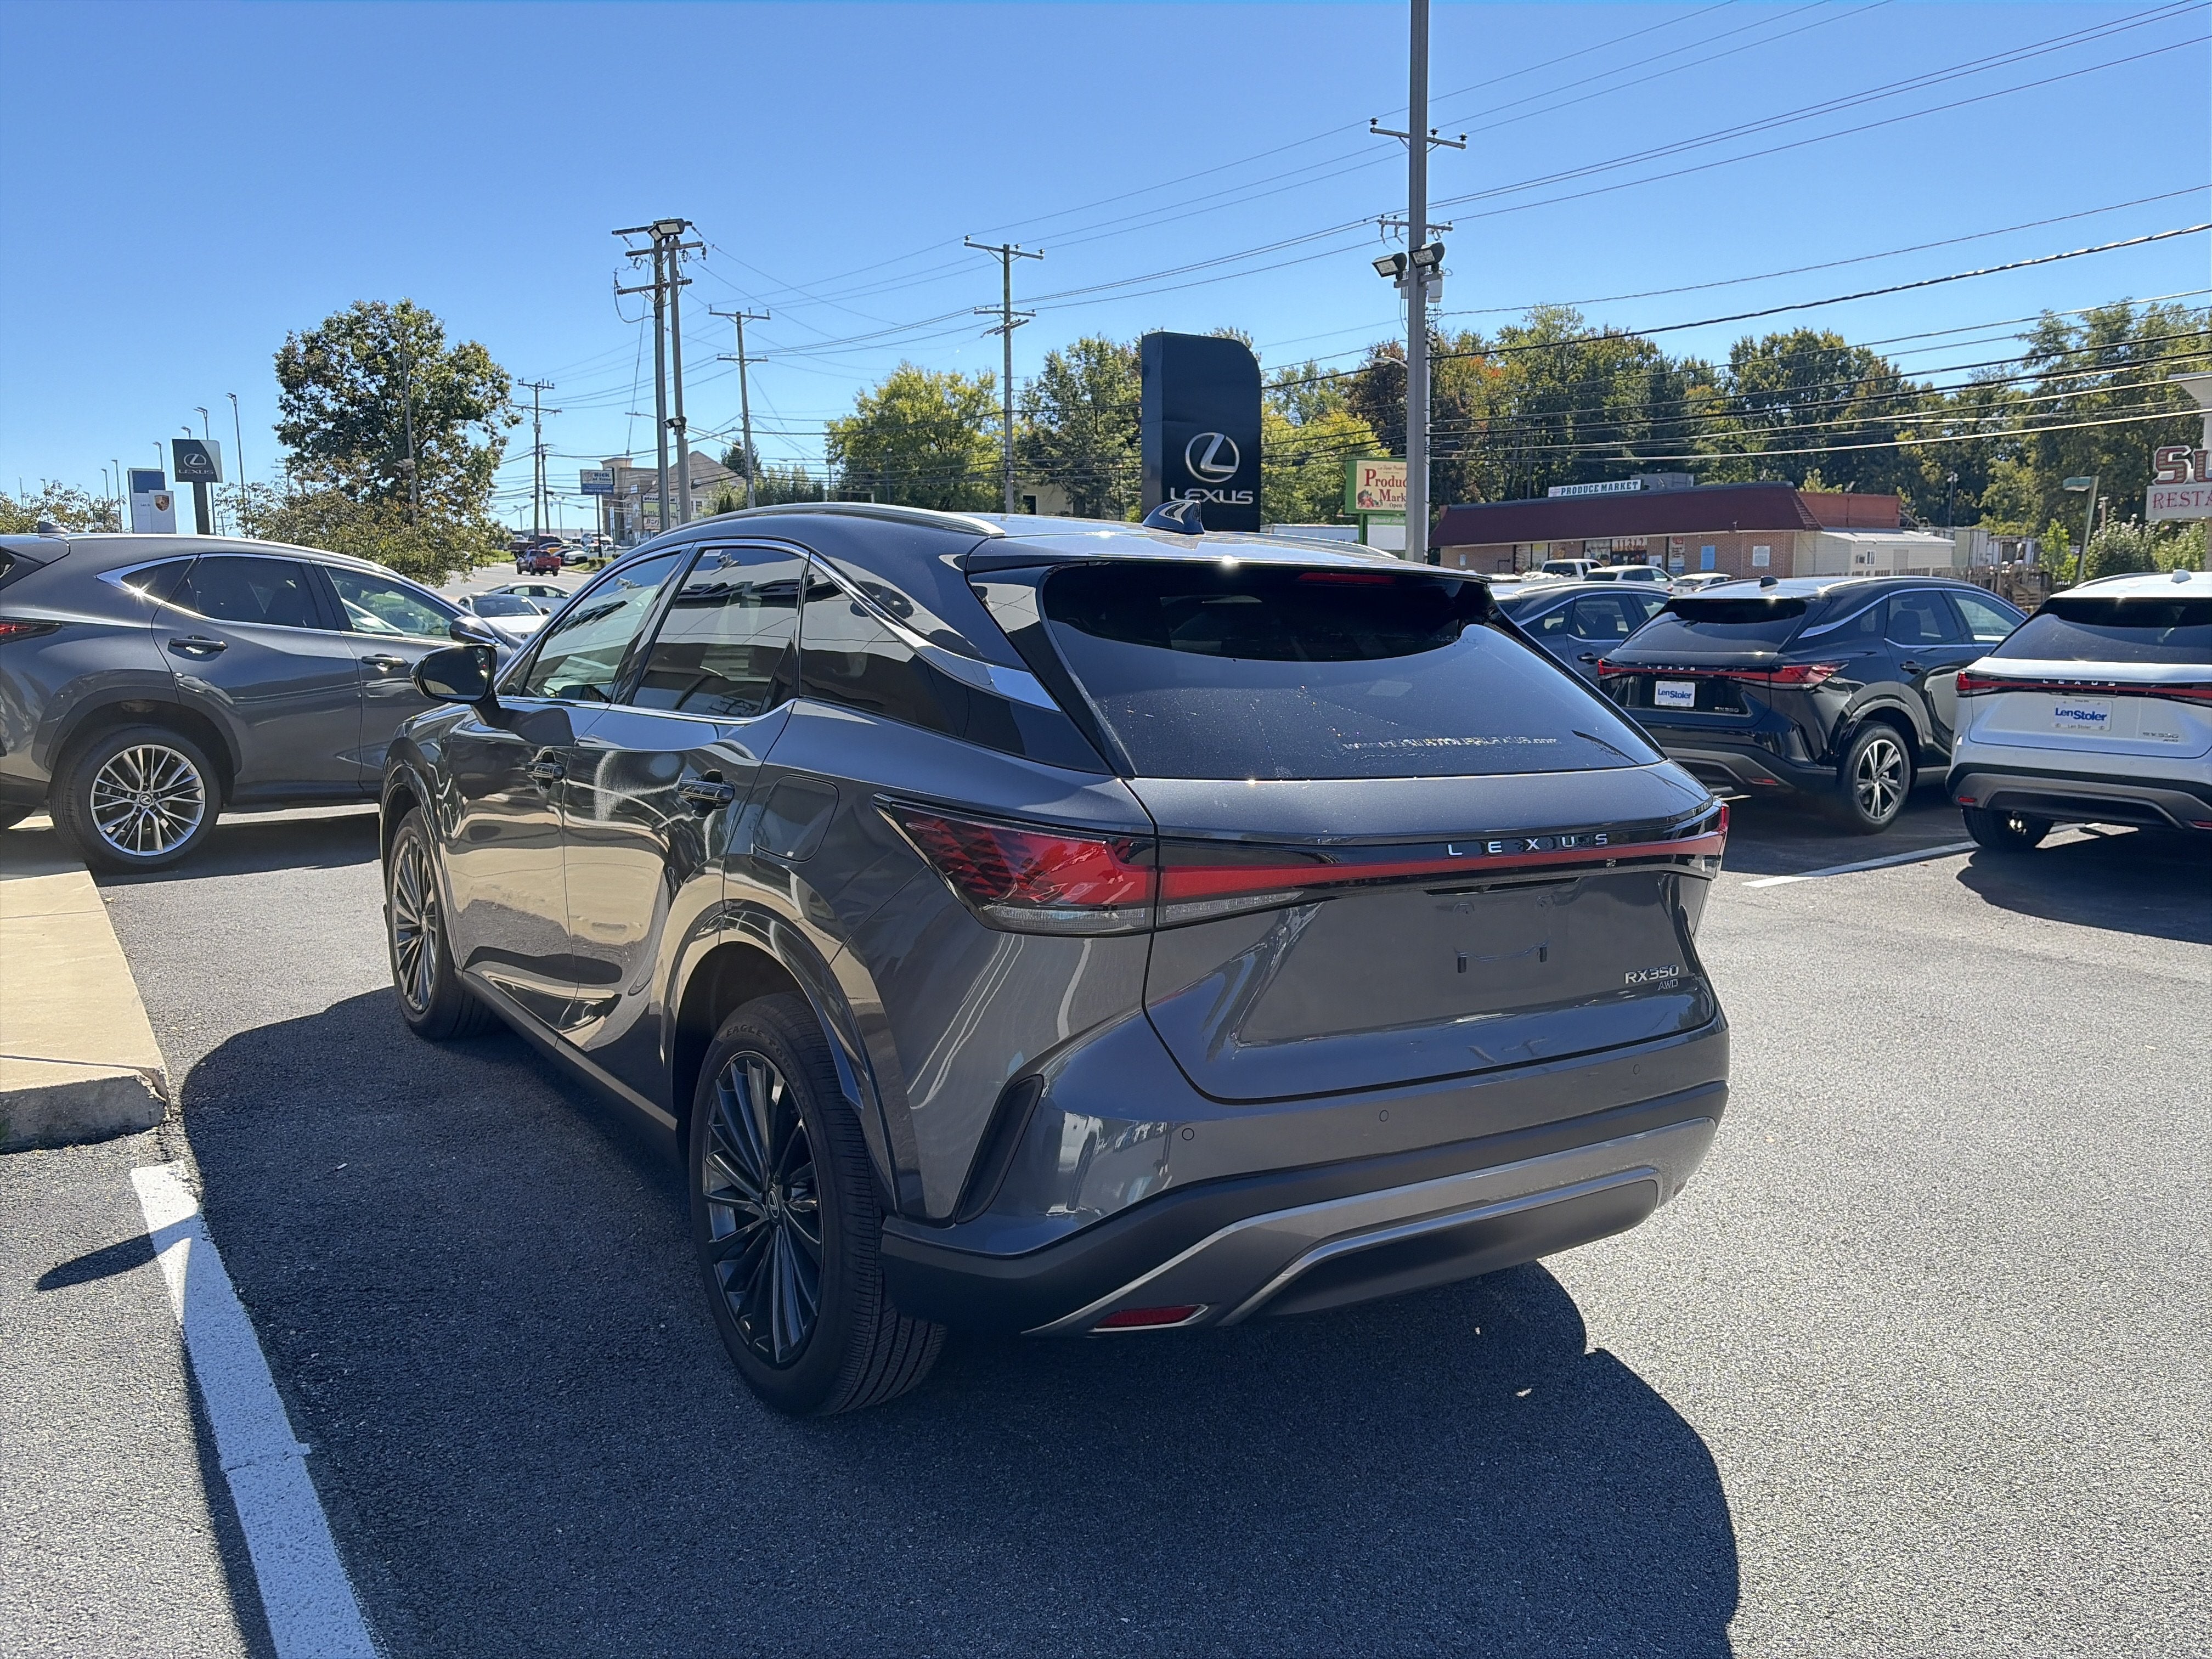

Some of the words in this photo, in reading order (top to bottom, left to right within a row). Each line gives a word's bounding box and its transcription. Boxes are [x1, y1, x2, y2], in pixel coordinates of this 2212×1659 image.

[1170, 487, 1254, 504] LEXUS
[1561, 484, 1599, 495] PRODUCE
[1601, 481, 1639, 492] MARKET
[1448, 833, 1609, 855] LEXUS
[1625, 964, 1679, 984] RX350
[1657, 978, 1678, 991] AWD
[726, 1024, 764, 1037] EAGLE
